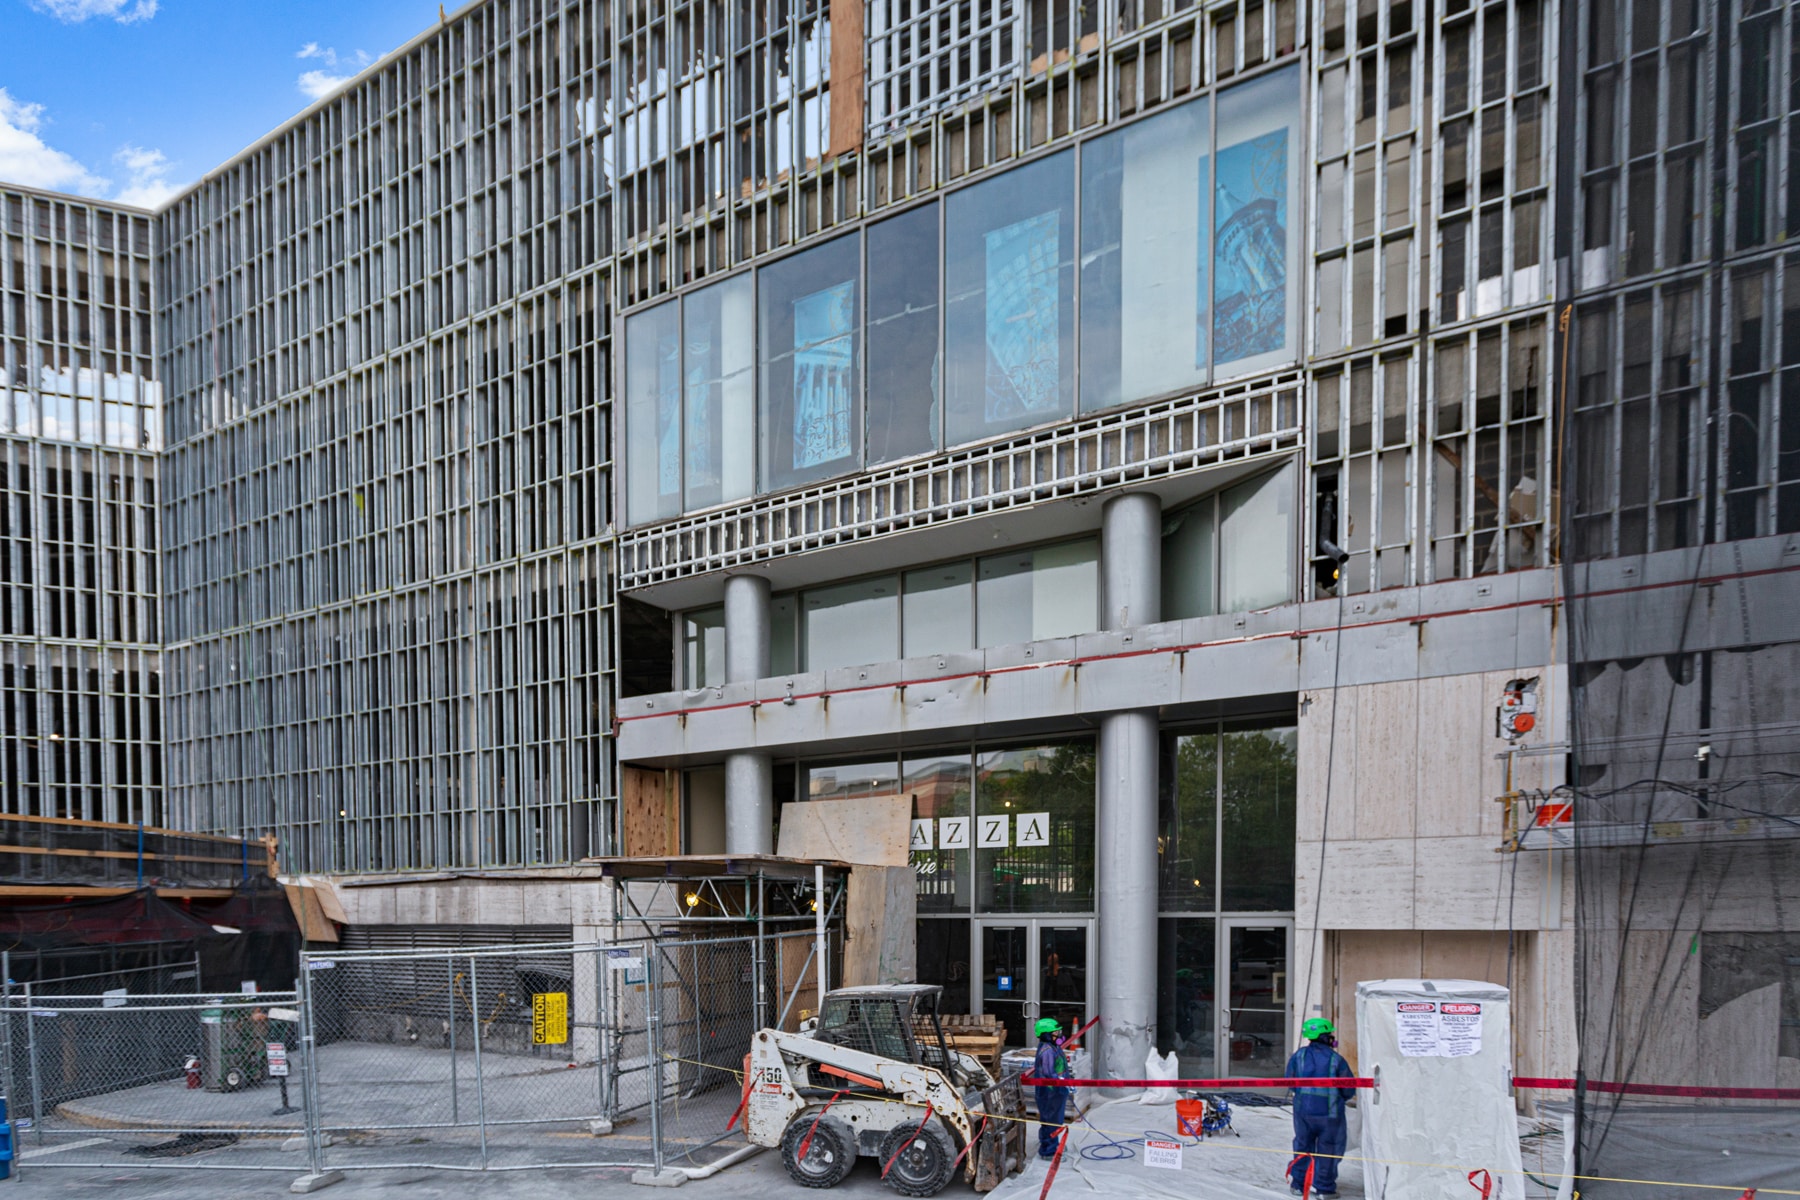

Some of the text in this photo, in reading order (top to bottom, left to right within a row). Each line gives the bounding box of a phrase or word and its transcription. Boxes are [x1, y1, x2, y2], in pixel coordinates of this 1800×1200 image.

[1445, 1004, 1477, 1012] PELIGRO
[535, 995, 545, 1043] CAUTION
[1151, 1141, 1176, 1149] DANGER
[1149, 1150, 1178, 1158] FALLING
[1150, 1156, 1177, 1165] DEBRIS
